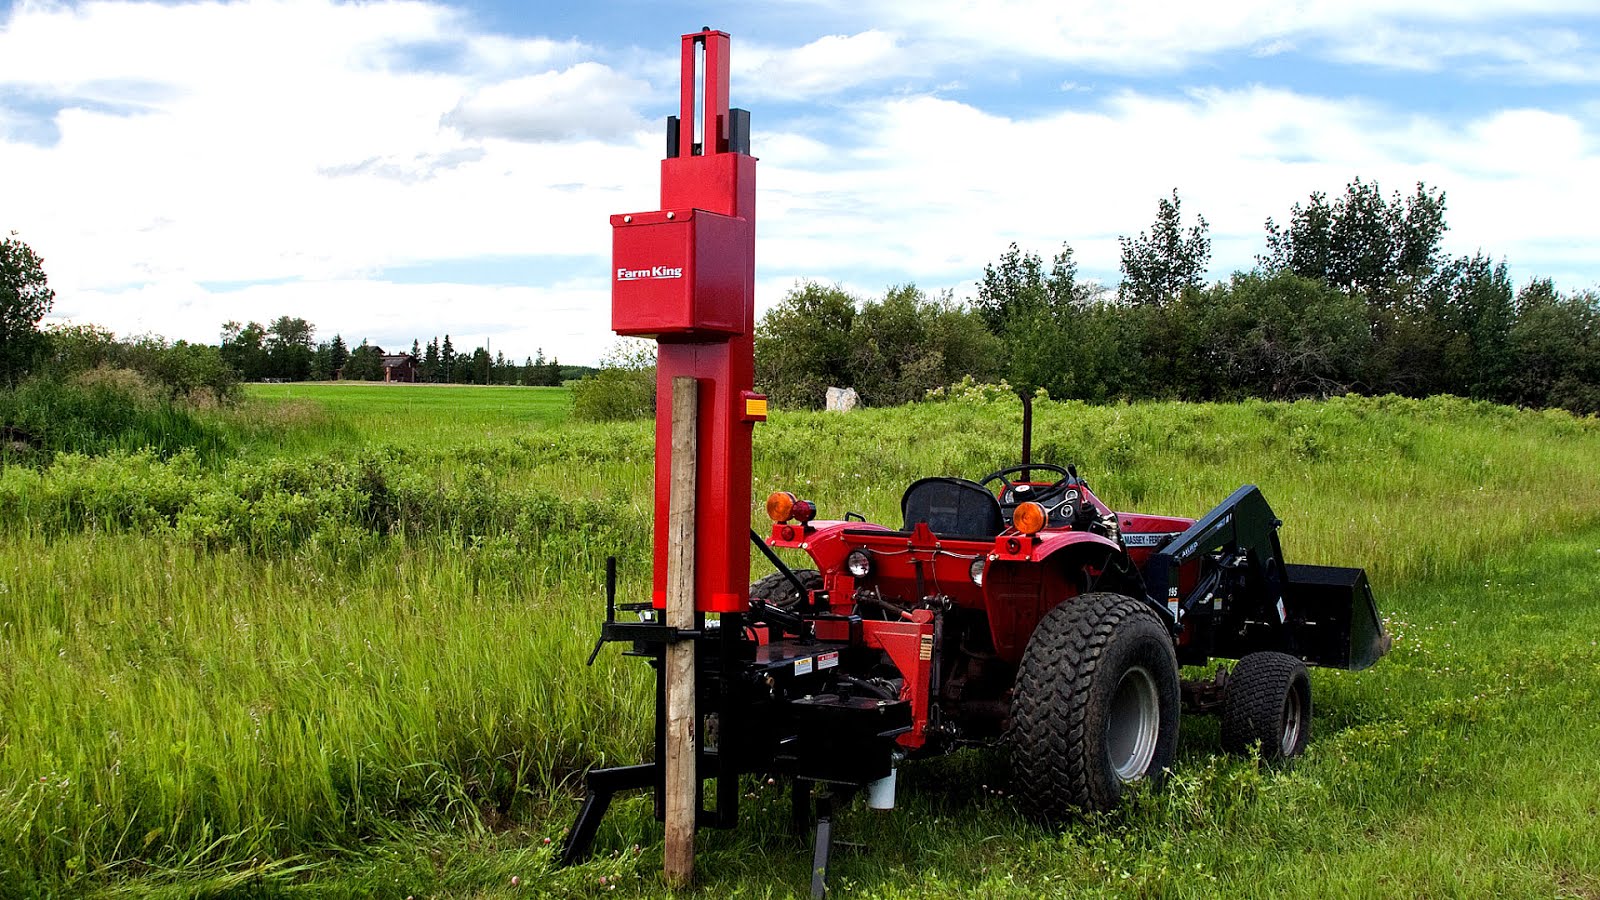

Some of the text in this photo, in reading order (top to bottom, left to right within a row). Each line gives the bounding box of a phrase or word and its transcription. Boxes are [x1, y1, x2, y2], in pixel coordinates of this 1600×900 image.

[617, 266, 682, 278] Farm King
[1168, 587, 1178, 597] 195
